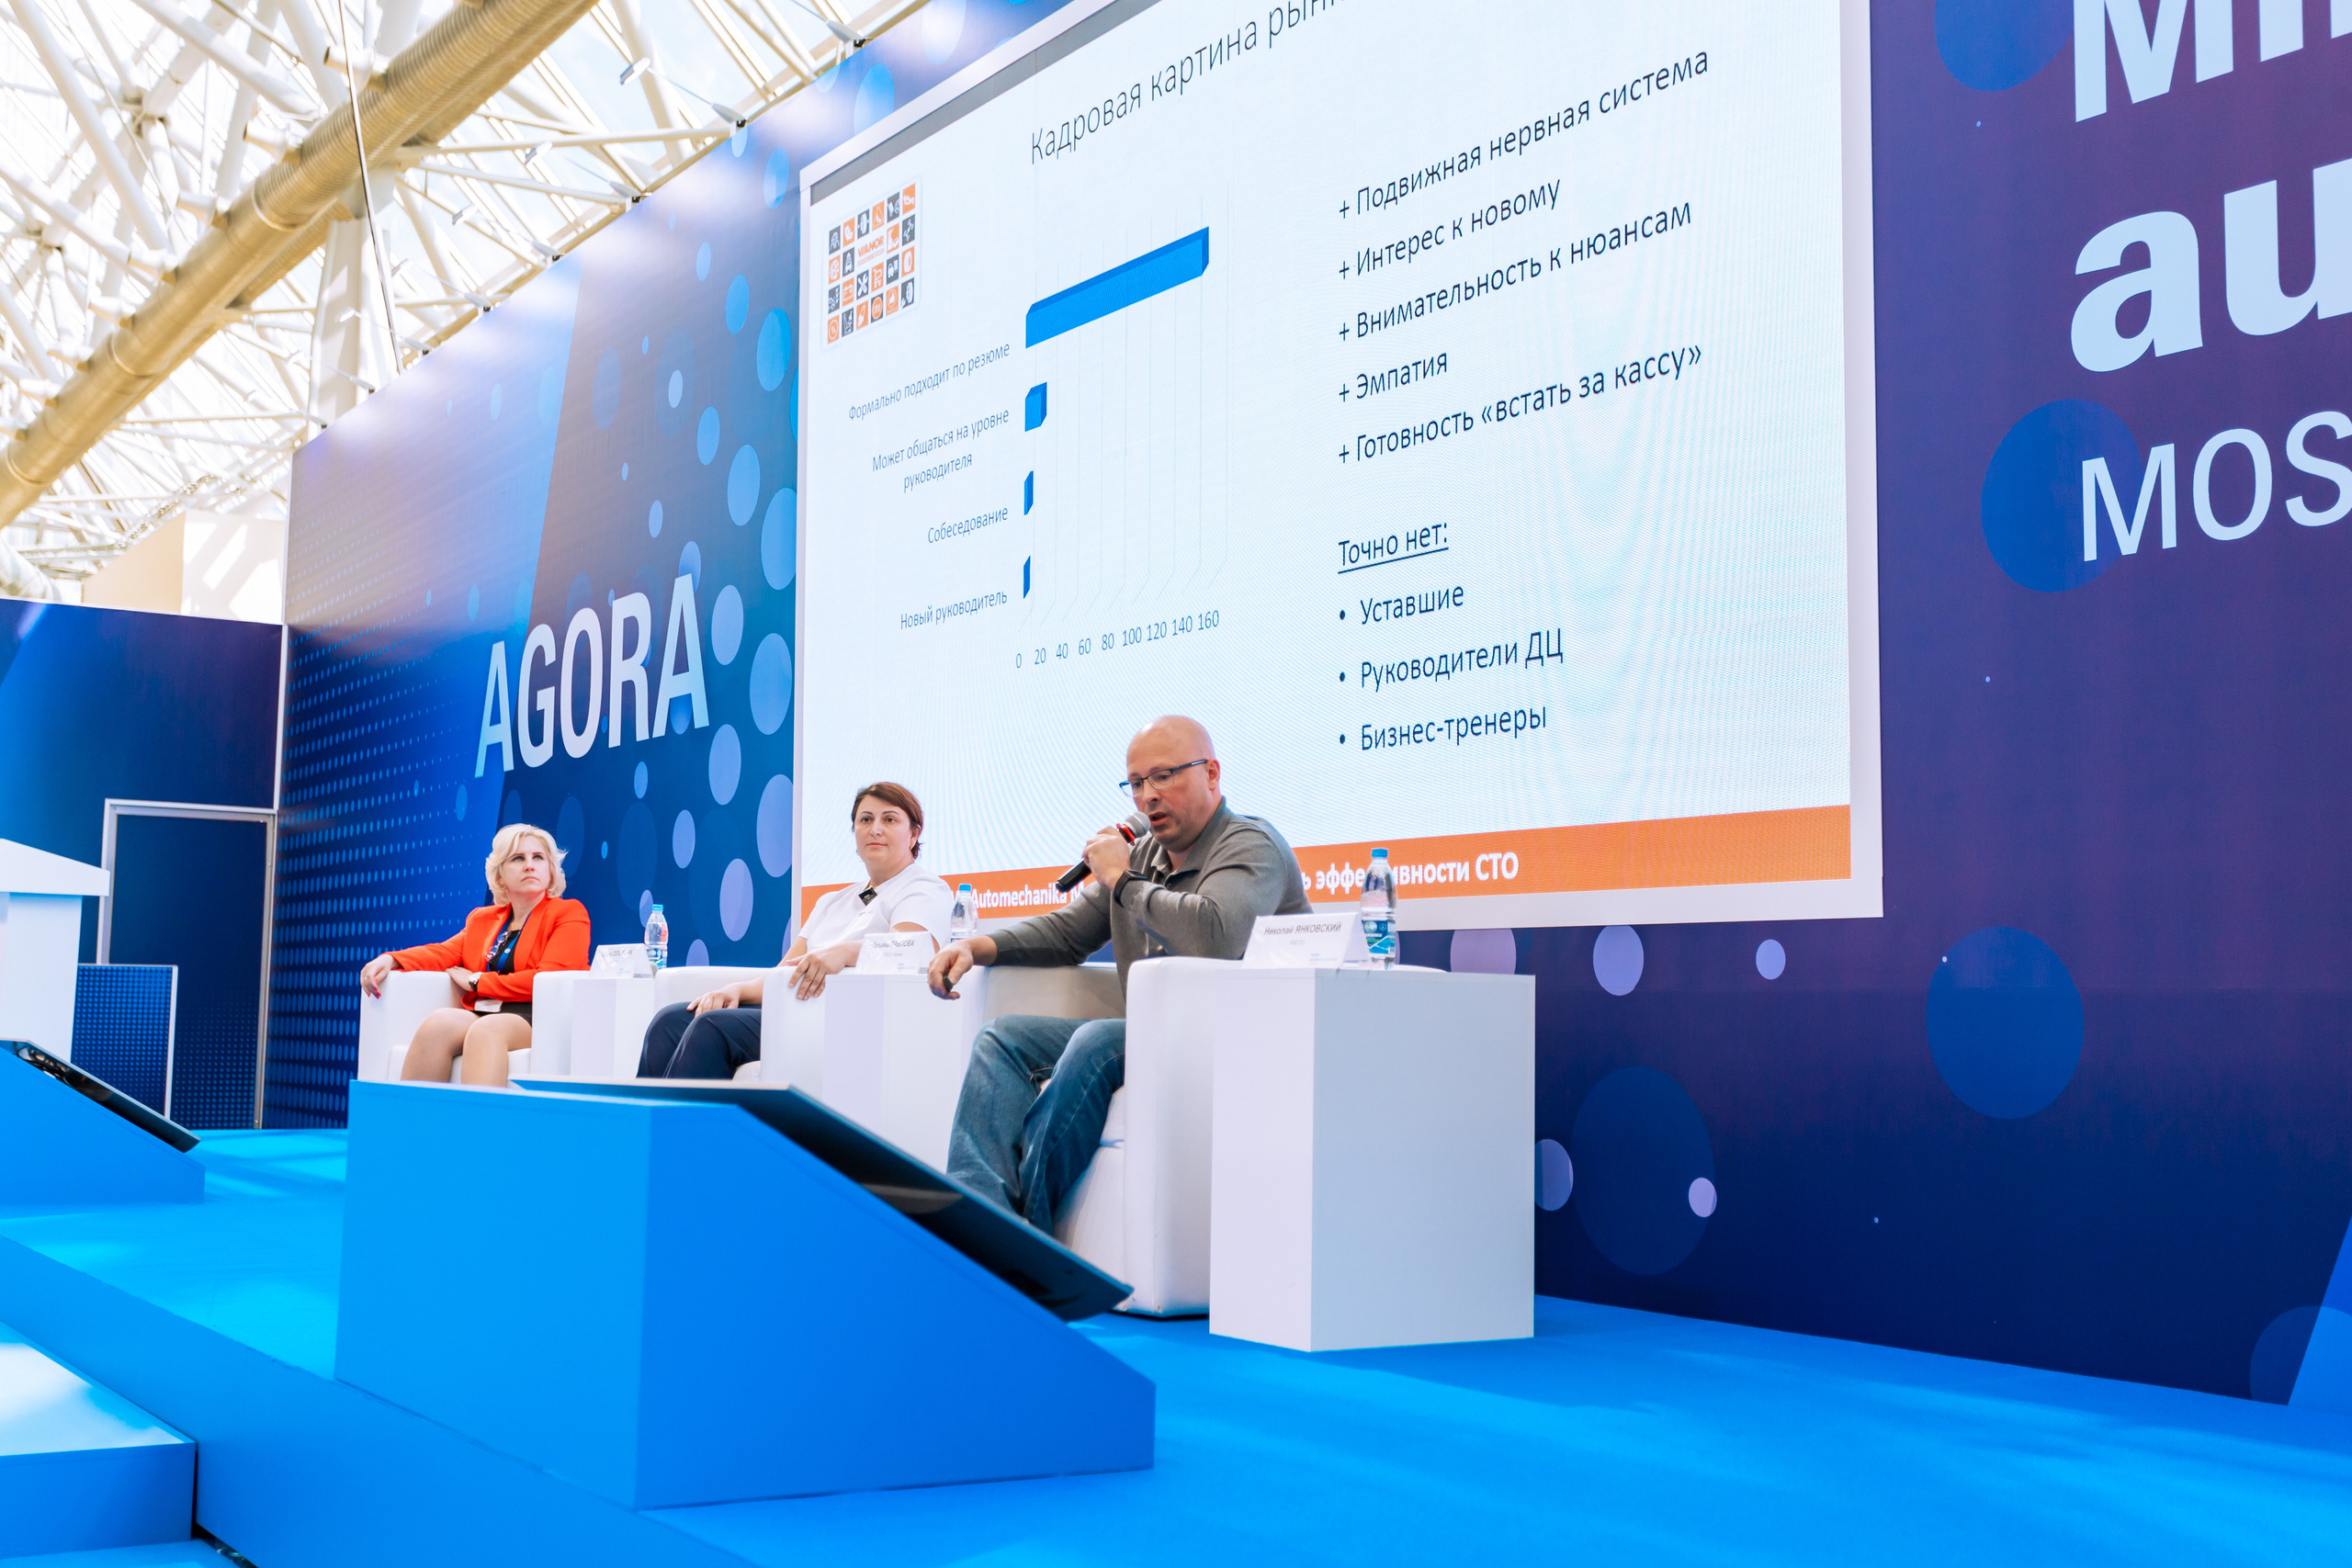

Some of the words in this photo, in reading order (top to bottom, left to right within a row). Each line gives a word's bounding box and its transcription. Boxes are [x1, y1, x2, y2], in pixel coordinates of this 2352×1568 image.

[1032, 83, 1141, 165] Кадровая
[1151, 20, 1257, 102] картина
[1268, 0, 1336, 51] рын
[1356, 145, 1483, 216] Подвижная
[1489, 99, 1589, 161] нервная
[1599, 51, 1708, 114] система
[1357, 225, 1445, 276] Интерес
[1453, 217, 1463, 241] к
[1471, 179, 1561, 233] новому
[1356, 254, 1543, 340] Внимательность
[1550, 247, 1562, 272] к
[1570, 201, 1691, 265] нюансам
[2071, 158, 2352, 372] au
[848, 389, 902, 421] Формально
[904, 367, 951, 399] подходит
[952, 360, 967, 378] по
[967, 344, 1011, 376] резюме
[1356, 352, 1448, 400] Эмпатия
[1357, 411, 1475, 462] Готовность
[1481, 383, 1571, 424] «встать
[1578, 371, 1605, 399] за
[1614, 344, 1702, 389] кассу»
[871, 448, 906, 473] Может
[906, 430, 954, 459] общаться
[956, 425, 968, 441] на
[970, 410, 1010, 439] уровне
[903, 452, 973, 494] руководителя
[2082, 411, 2352, 562] MOS
[927, 507, 1009, 544] Собеседование
[1338, 533, 1400, 568] Точно
[1405, 520, 1450, 554] нет:
[899, 604, 934, 631] Новый
[935, 591, 1008, 626] руководитель
[1360, 585, 1464, 626] Уставшие
[1015, 652, 1023, 669] 0
[1034, 647, 1046, 665] 20
[1056, 642, 1069, 660] 40
[1078, 637, 1091, 656] 60
[1102, 632, 1115, 651] 80
[1122, 626, 1143, 647] 100
[1147, 621, 1168, 642] 120
[1172, 615, 1193, 637] 140
[1197, 610, 1220, 631] 160
[1361, 640, 1519, 694] Руководители
[1524, 626, 1565, 670] ДЦ
[474, 573, 709, 778] AGORA
[1361, 705, 1546, 751] Бизнес-тренеры
[970, 882, 1068, 908] Automechanika
[1316, 861, 1470, 896] эффевности
[1476, 852, 1519, 881] СТО
[1264, 926, 1294, 935] Николай
[1295, 921, 1341, 933] ЯНКОВСКИЙ
